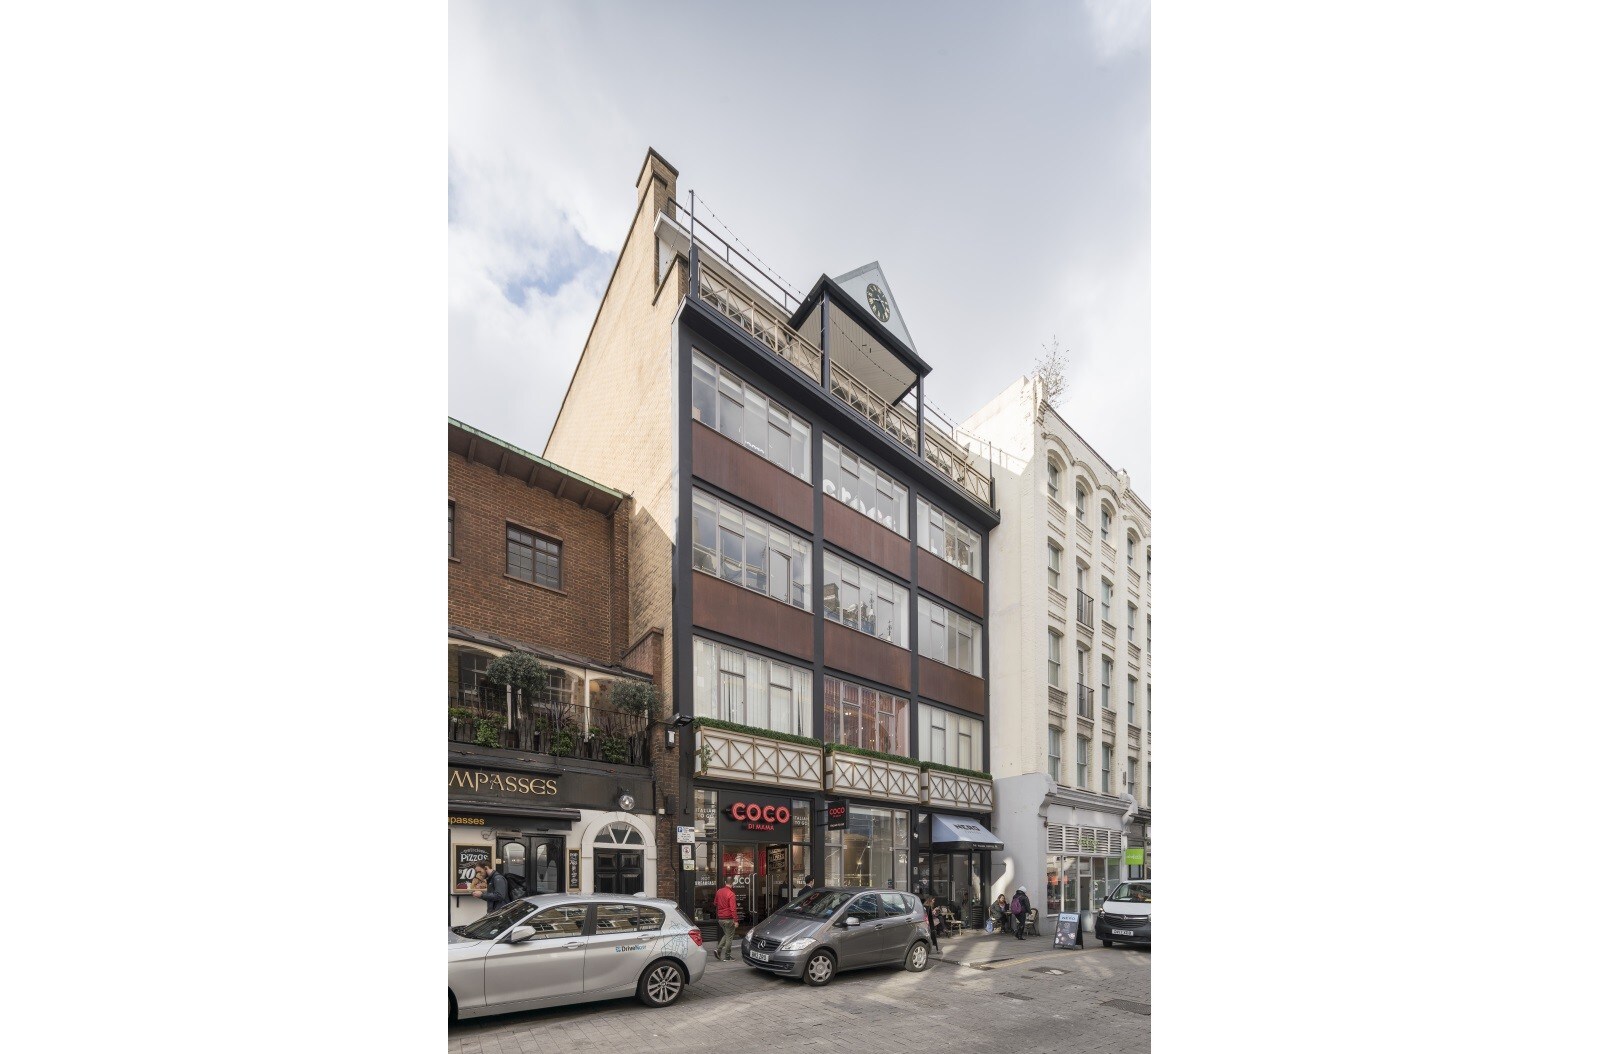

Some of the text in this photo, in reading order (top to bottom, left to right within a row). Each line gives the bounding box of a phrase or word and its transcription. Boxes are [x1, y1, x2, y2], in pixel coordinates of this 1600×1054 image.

[448, 770, 557, 795] MPASSES
[732, 801, 790, 824] COCO
[829, 806, 845, 816] COCO
[448, 816, 485, 826] passes
[953, 823, 981, 832] NERO
